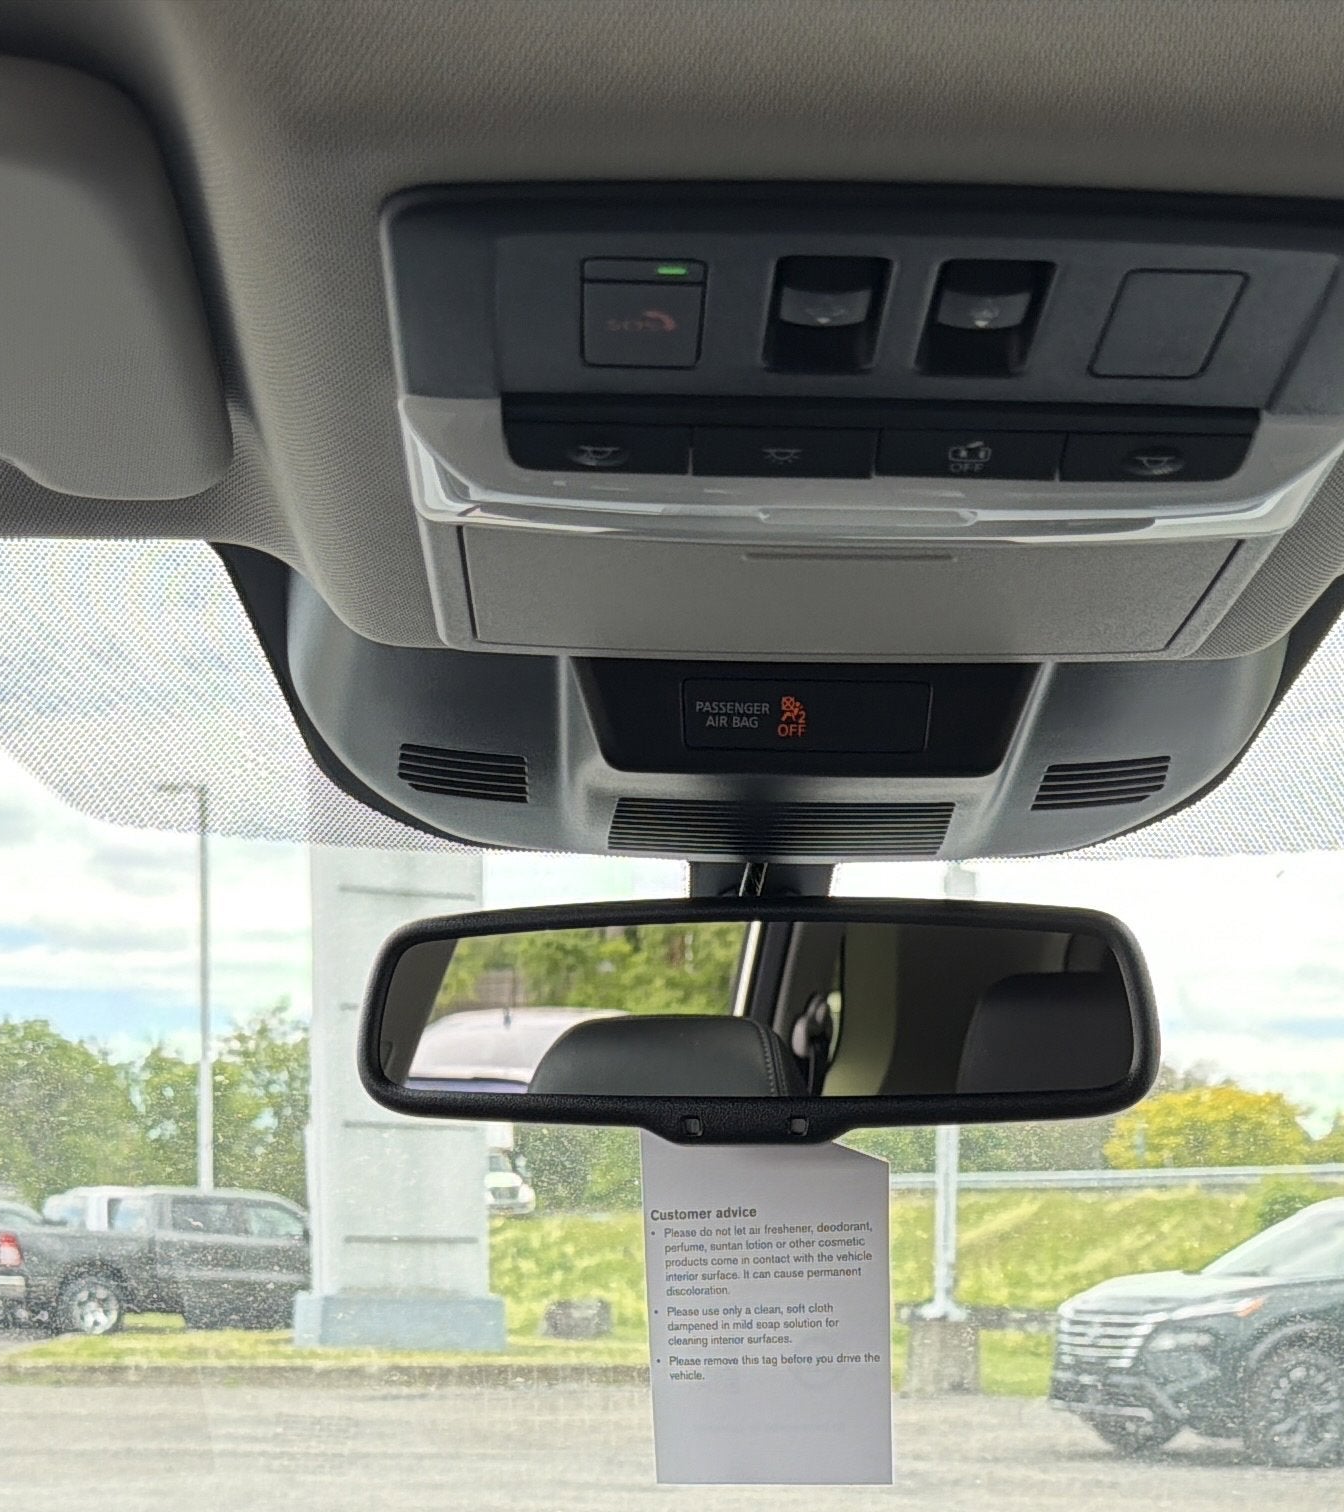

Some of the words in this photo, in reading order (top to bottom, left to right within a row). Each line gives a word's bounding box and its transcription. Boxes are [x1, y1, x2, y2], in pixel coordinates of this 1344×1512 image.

[696, 701, 769, 714] PASSENGER
[706, 716, 728, 727] AIR
[732, 717, 758, 728] BAG
[778, 725, 806, 736] OFF
[650, 1208, 712, 1220] Customer
[715, 1205, 757, 1218] advice
[664, 1227, 697, 1238] Please
[699, 1226, 713, 1236] do
[715, 1227, 731, 1236] not
[734, 1225, 746, 1235] let
[764, 1222, 814, 1234] freshener,
[816, 1220, 873, 1233] deodorant,
[664, 1241, 707, 1254] perfume,
[709, 1241, 743, 1251] suntan
[745, 1238, 773, 1250] lotion
[788, 1237, 816, 1248] other
[817, 1236, 866, 1247] cosmetic
[665, 1256, 708, 1267] products
[710, 1257, 738, 1265] come
[741, 1256, 750, 1264] in
[752, 1254, 790, 1264] contact
[792, 1252, 814, 1263] with
[817, 1251, 834, 1262] the
[835, 1250, 873, 1262] vehicle
[665, 1271, 698, 1281] interior
[701, 1269, 740, 1280] surface.
[743, 1269, 749, 1279] It
[752, 1270, 771, 1279] can
[773, 1269, 804, 1278] cause
[806, 1267, 862, 1278] permanent
[665, 1285, 730, 1296] discoloration.
[666, 1306, 699, 1316] Please
[722, 1304, 742, 1317] only
[753, 1304, 783, 1315] clean,
[786, 1303, 805, 1314] soft
[808, 1302, 834, 1313] cloth
